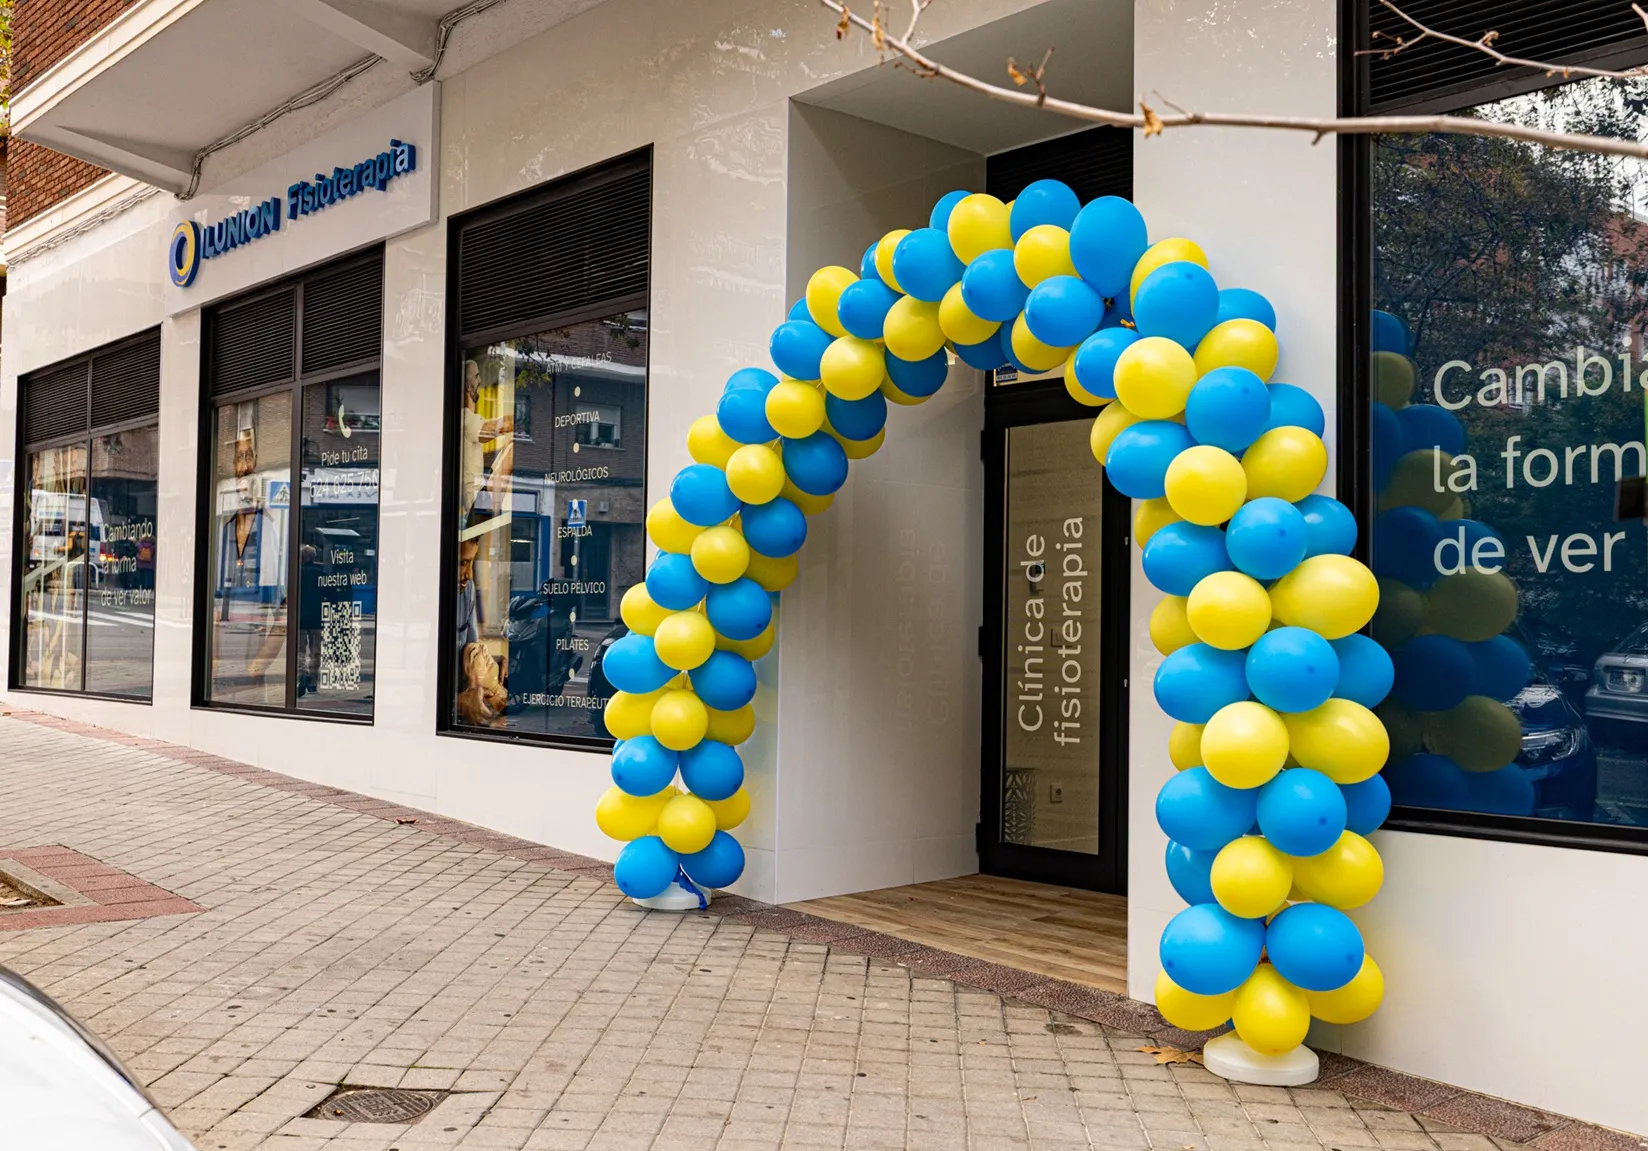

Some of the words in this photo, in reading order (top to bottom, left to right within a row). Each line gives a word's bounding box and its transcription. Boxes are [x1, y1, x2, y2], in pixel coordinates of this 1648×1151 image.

[200, 197, 281, 259] ILUNION
[287, 139, 416, 220] Fisioterapia
[571, 351, 612, 370] CEFALEAS
[1434, 336, 1648, 410] Cambi
[555, 410, 600, 428] DEPORTIVA
[321, 451, 340, 466] Pide
[341, 449, 350, 464] tu
[352, 445, 368, 462] cita
[544, 466, 609, 485] NEUROLÓGICOS
[1433, 445, 1478, 493] la
[310, 477, 330, 498] 624
[333, 472, 354, 495] 625
[102, 517, 153, 542] Cambiando
[557, 525, 593, 538] ESPALDA
[330, 548, 354, 565] Visita
[1020, 534, 1046, 583] de
[1433, 525, 1506, 576] de
[1526, 530, 1626, 574] ver
[111, 550, 136, 575] forma
[317, 572, 348, 587] nuestra
[349, 569, 367, 586] web
[543, 583, 569, 595] SUELO
[570, 580, 605, 593] PÉLVICO
[101, 587, 112, 606] de
[113, 588, 128, 606] ver
[129, 585, 152, 604] valor
[1054, 517, 1088, 746] fisioterapia
[556, 638, 589, 651] PILATES
[1018, 598, 1044, 732] Clínica
[522, 692, 565, 706] EJERCICIO
